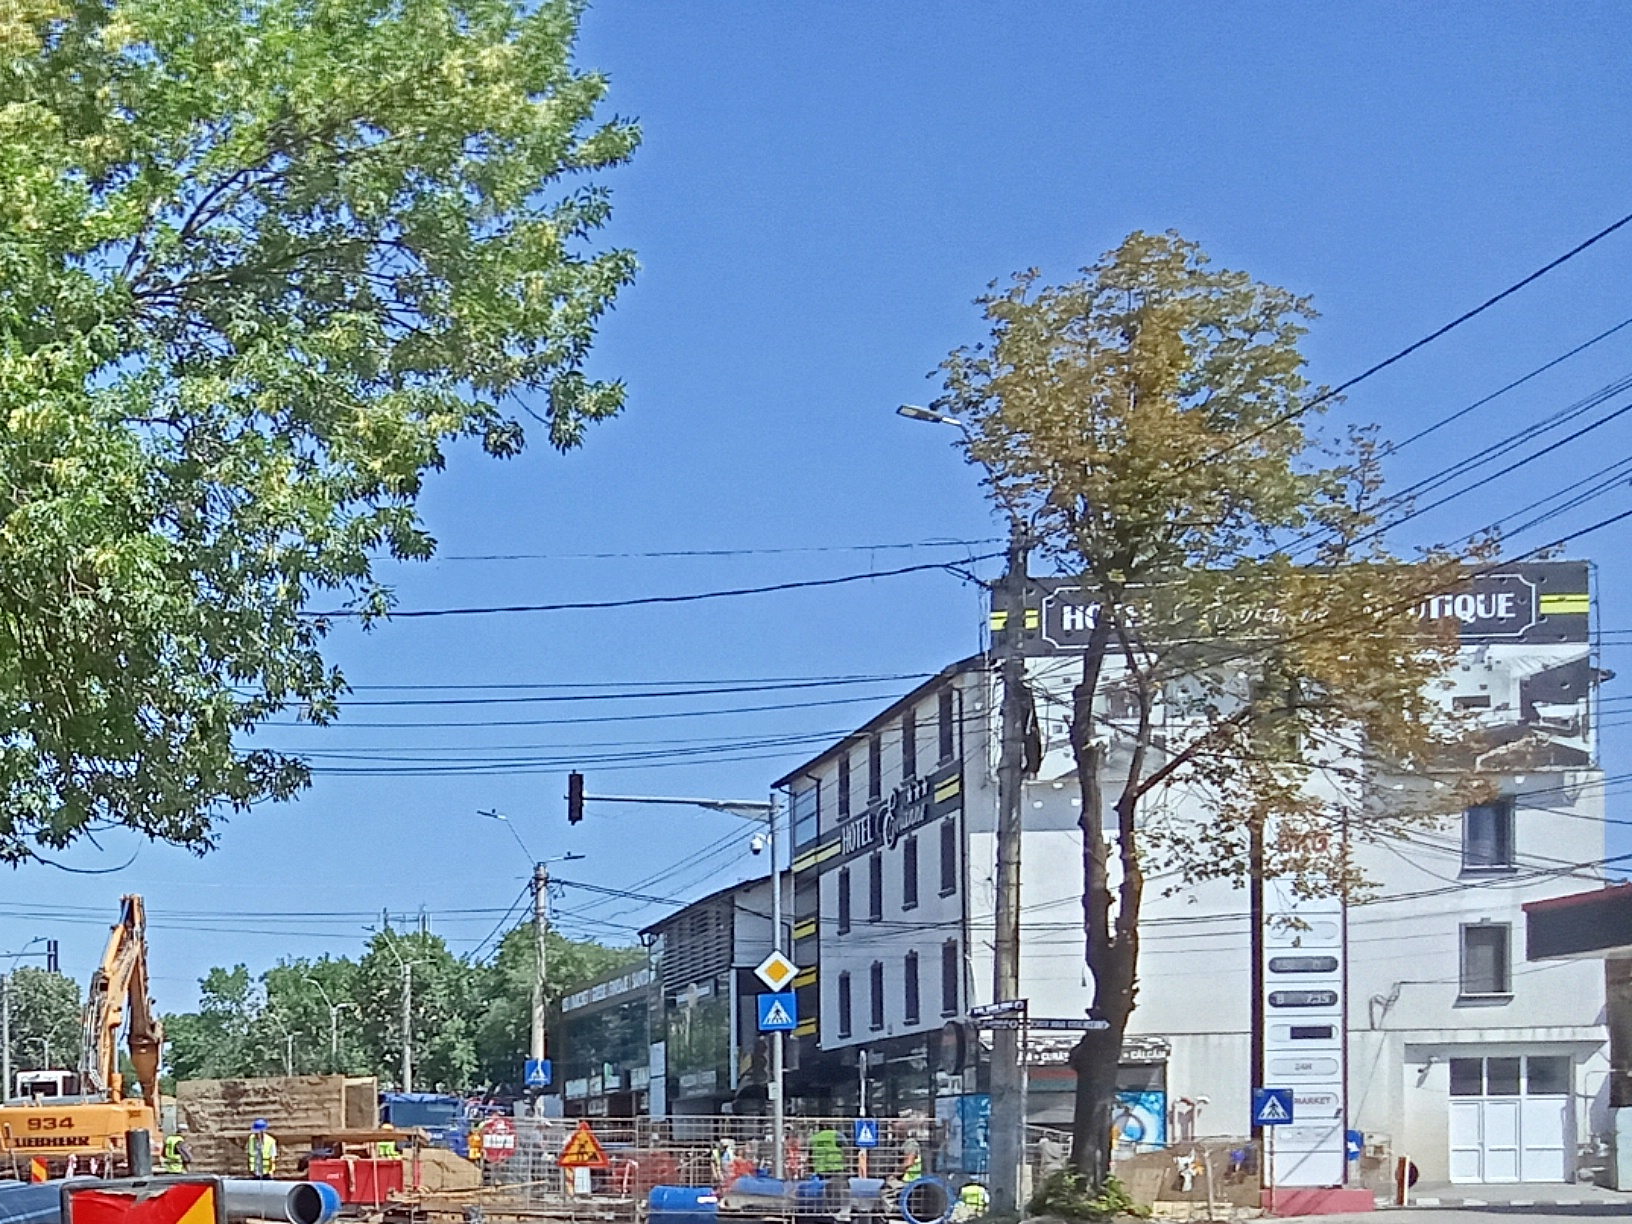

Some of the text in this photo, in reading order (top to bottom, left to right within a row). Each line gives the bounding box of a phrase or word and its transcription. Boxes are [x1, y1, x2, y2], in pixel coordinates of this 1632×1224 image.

[842, 813, 874, 855] HOTEL
[27, 1116, 75, 1131] 934
[14, 1136, 90, 1148] LIEBHERR
